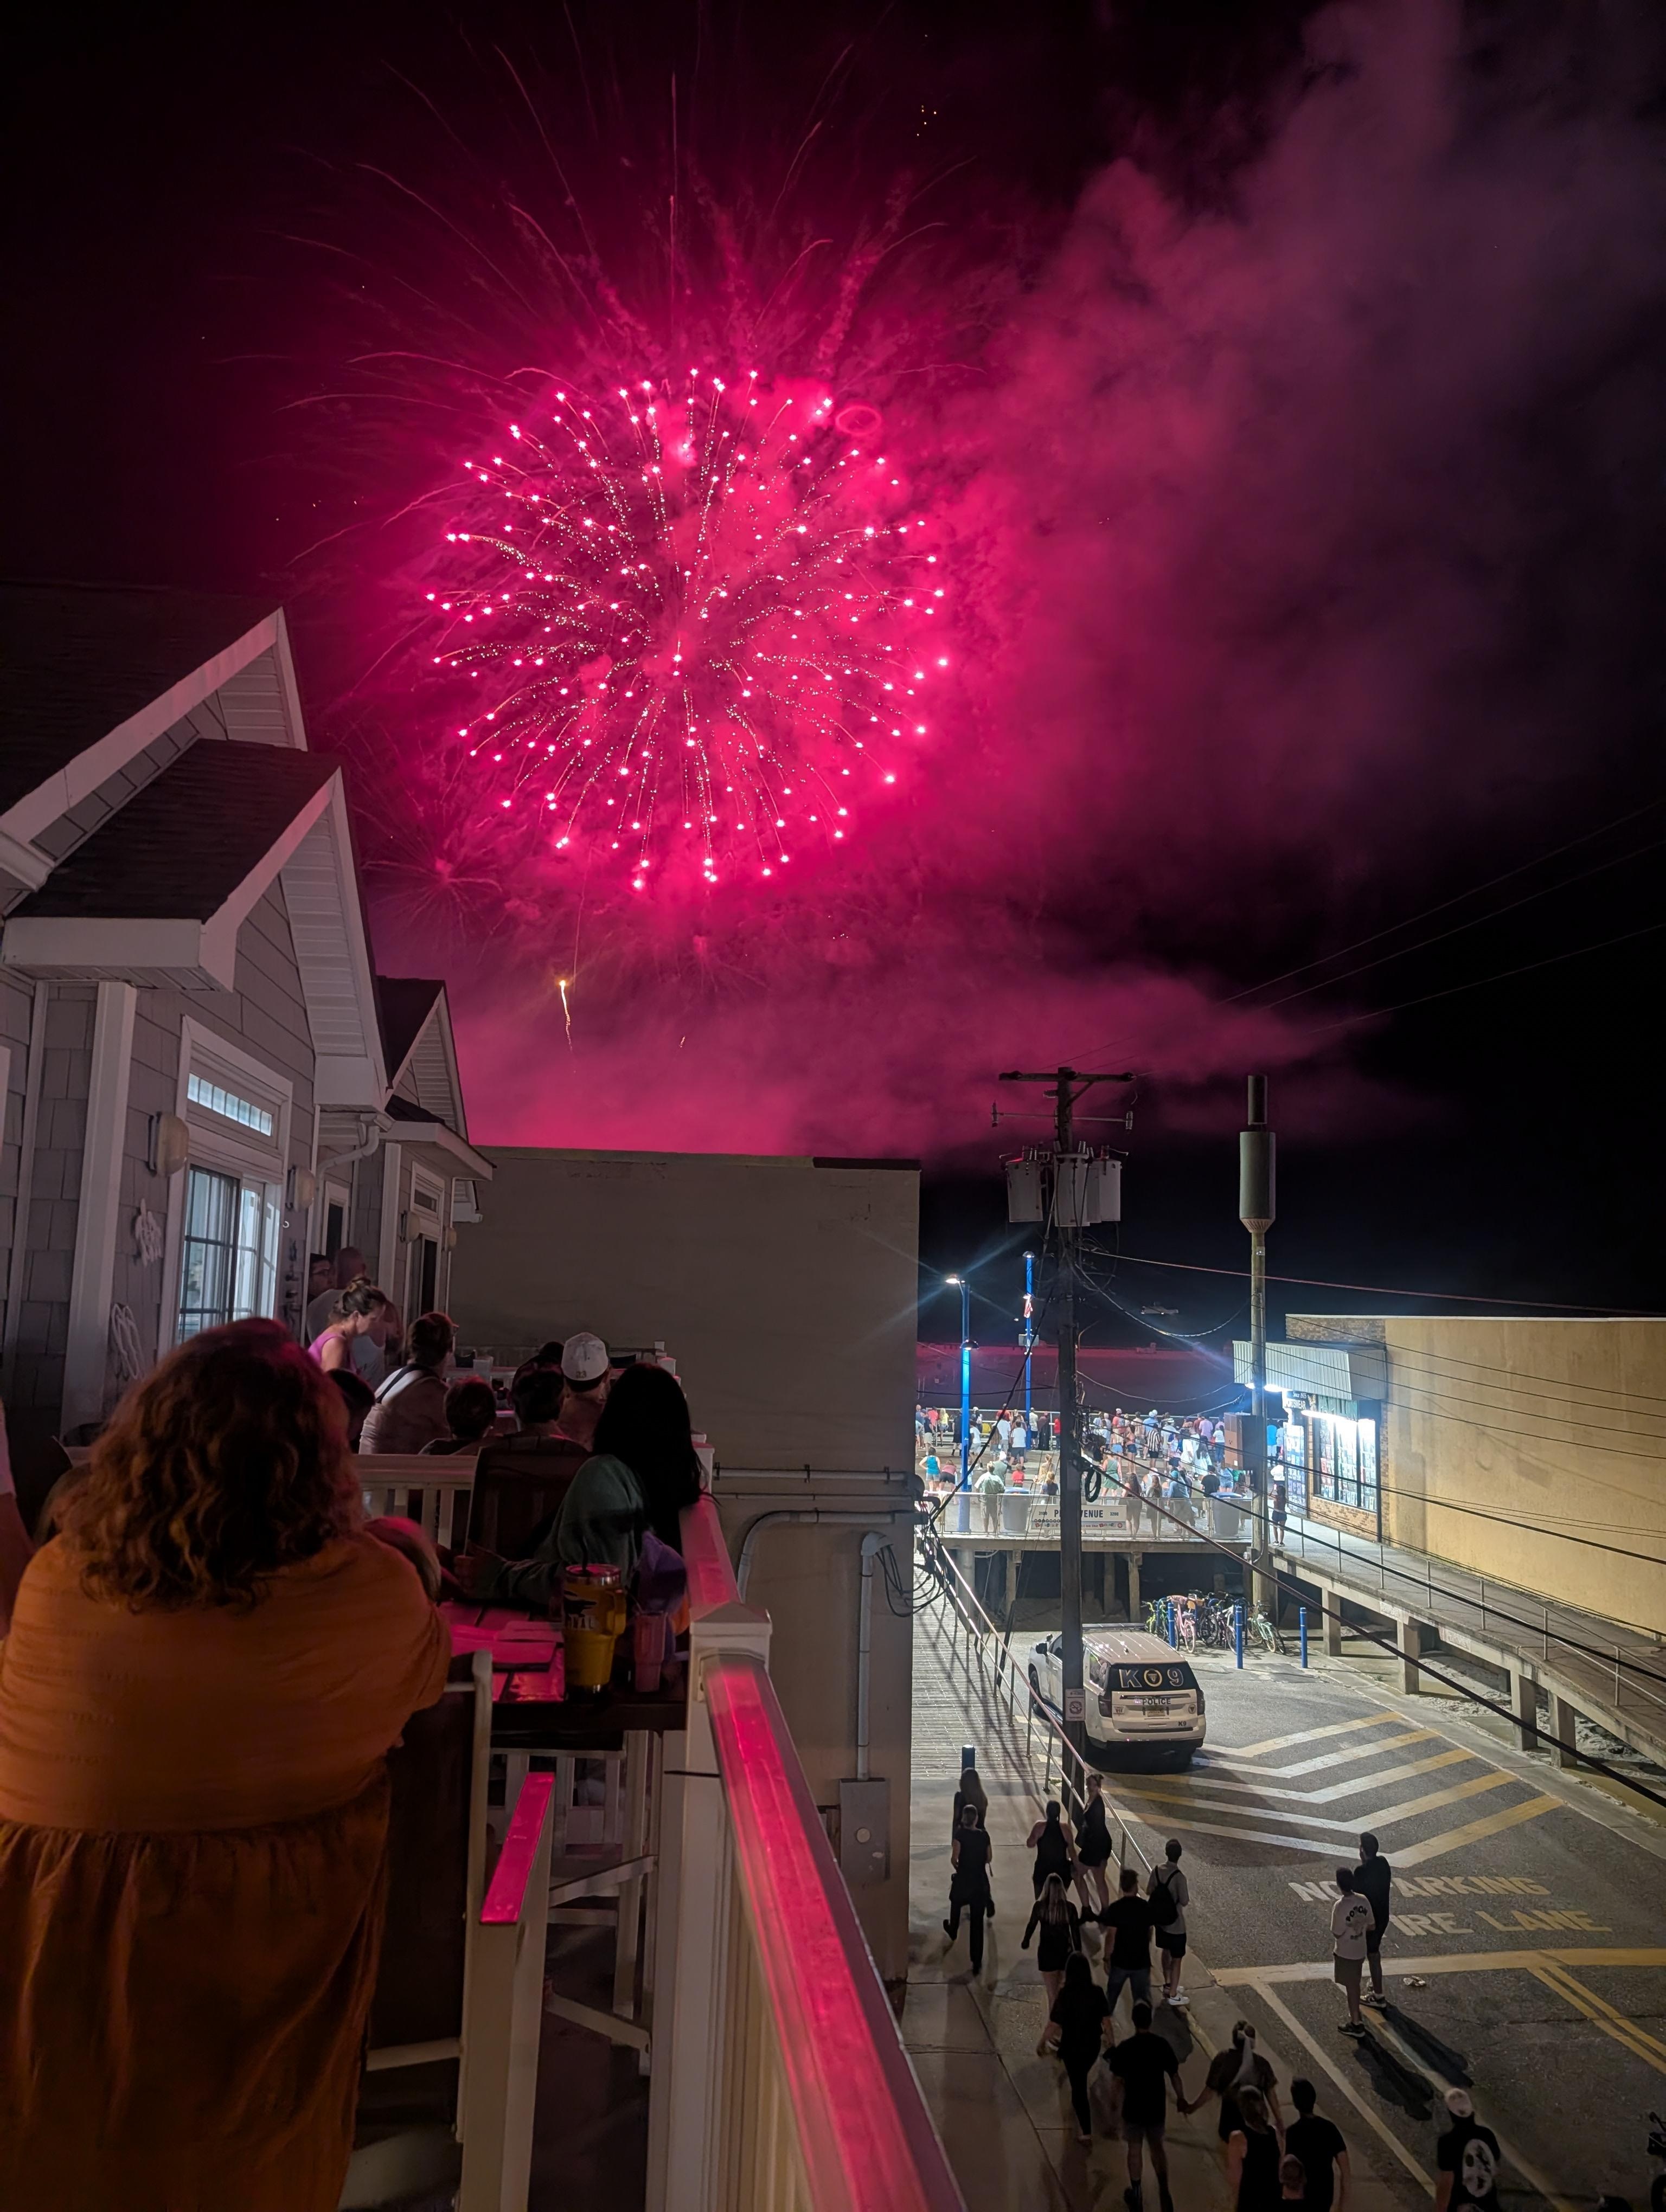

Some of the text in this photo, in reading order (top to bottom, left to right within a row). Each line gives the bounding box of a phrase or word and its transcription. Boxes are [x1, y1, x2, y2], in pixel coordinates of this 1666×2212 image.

[1081, 1509, 1104, 1518] VENUE
[1388, 1876, 1552, 1898] ARKING
[1382, 1912, 1474, 1937] IRE
[1475, 1910, 1612, 1932] LANE
